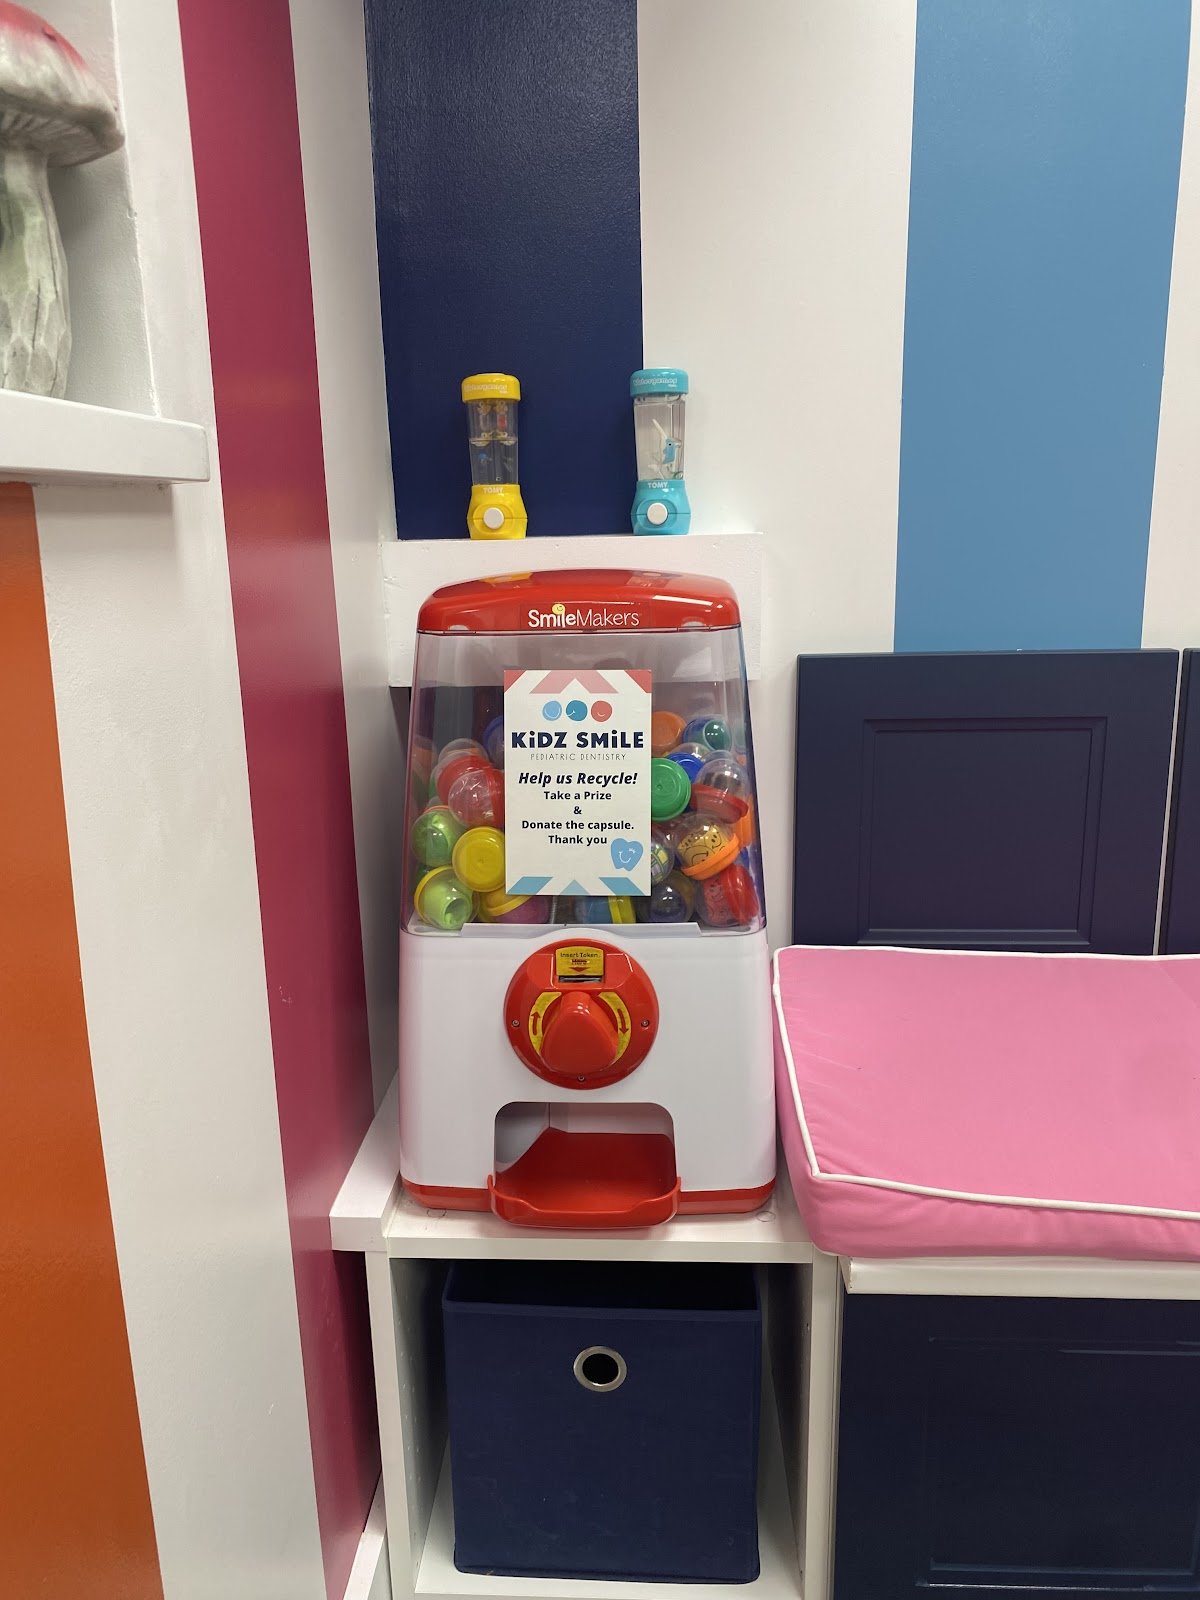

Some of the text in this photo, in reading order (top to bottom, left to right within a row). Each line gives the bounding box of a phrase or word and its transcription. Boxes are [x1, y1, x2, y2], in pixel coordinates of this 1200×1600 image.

[483, 486, 504, 494] TOMY
[647, 481, 668, 489] TOMY
[528, 604, 640, 628] SmileMakers
[530, 753, 626, 761] PEDIATRIC DENTISTRY
[518, 771, 638, 787] Help us Recycle!
[543, 791, 571, 800] Take
[584, 791, 612, 800] Prize
[573, 805, 582, 815] &
[521, 820, 634, 832] Donate the capsule.
[548, 834, 608, 847] Thank you
